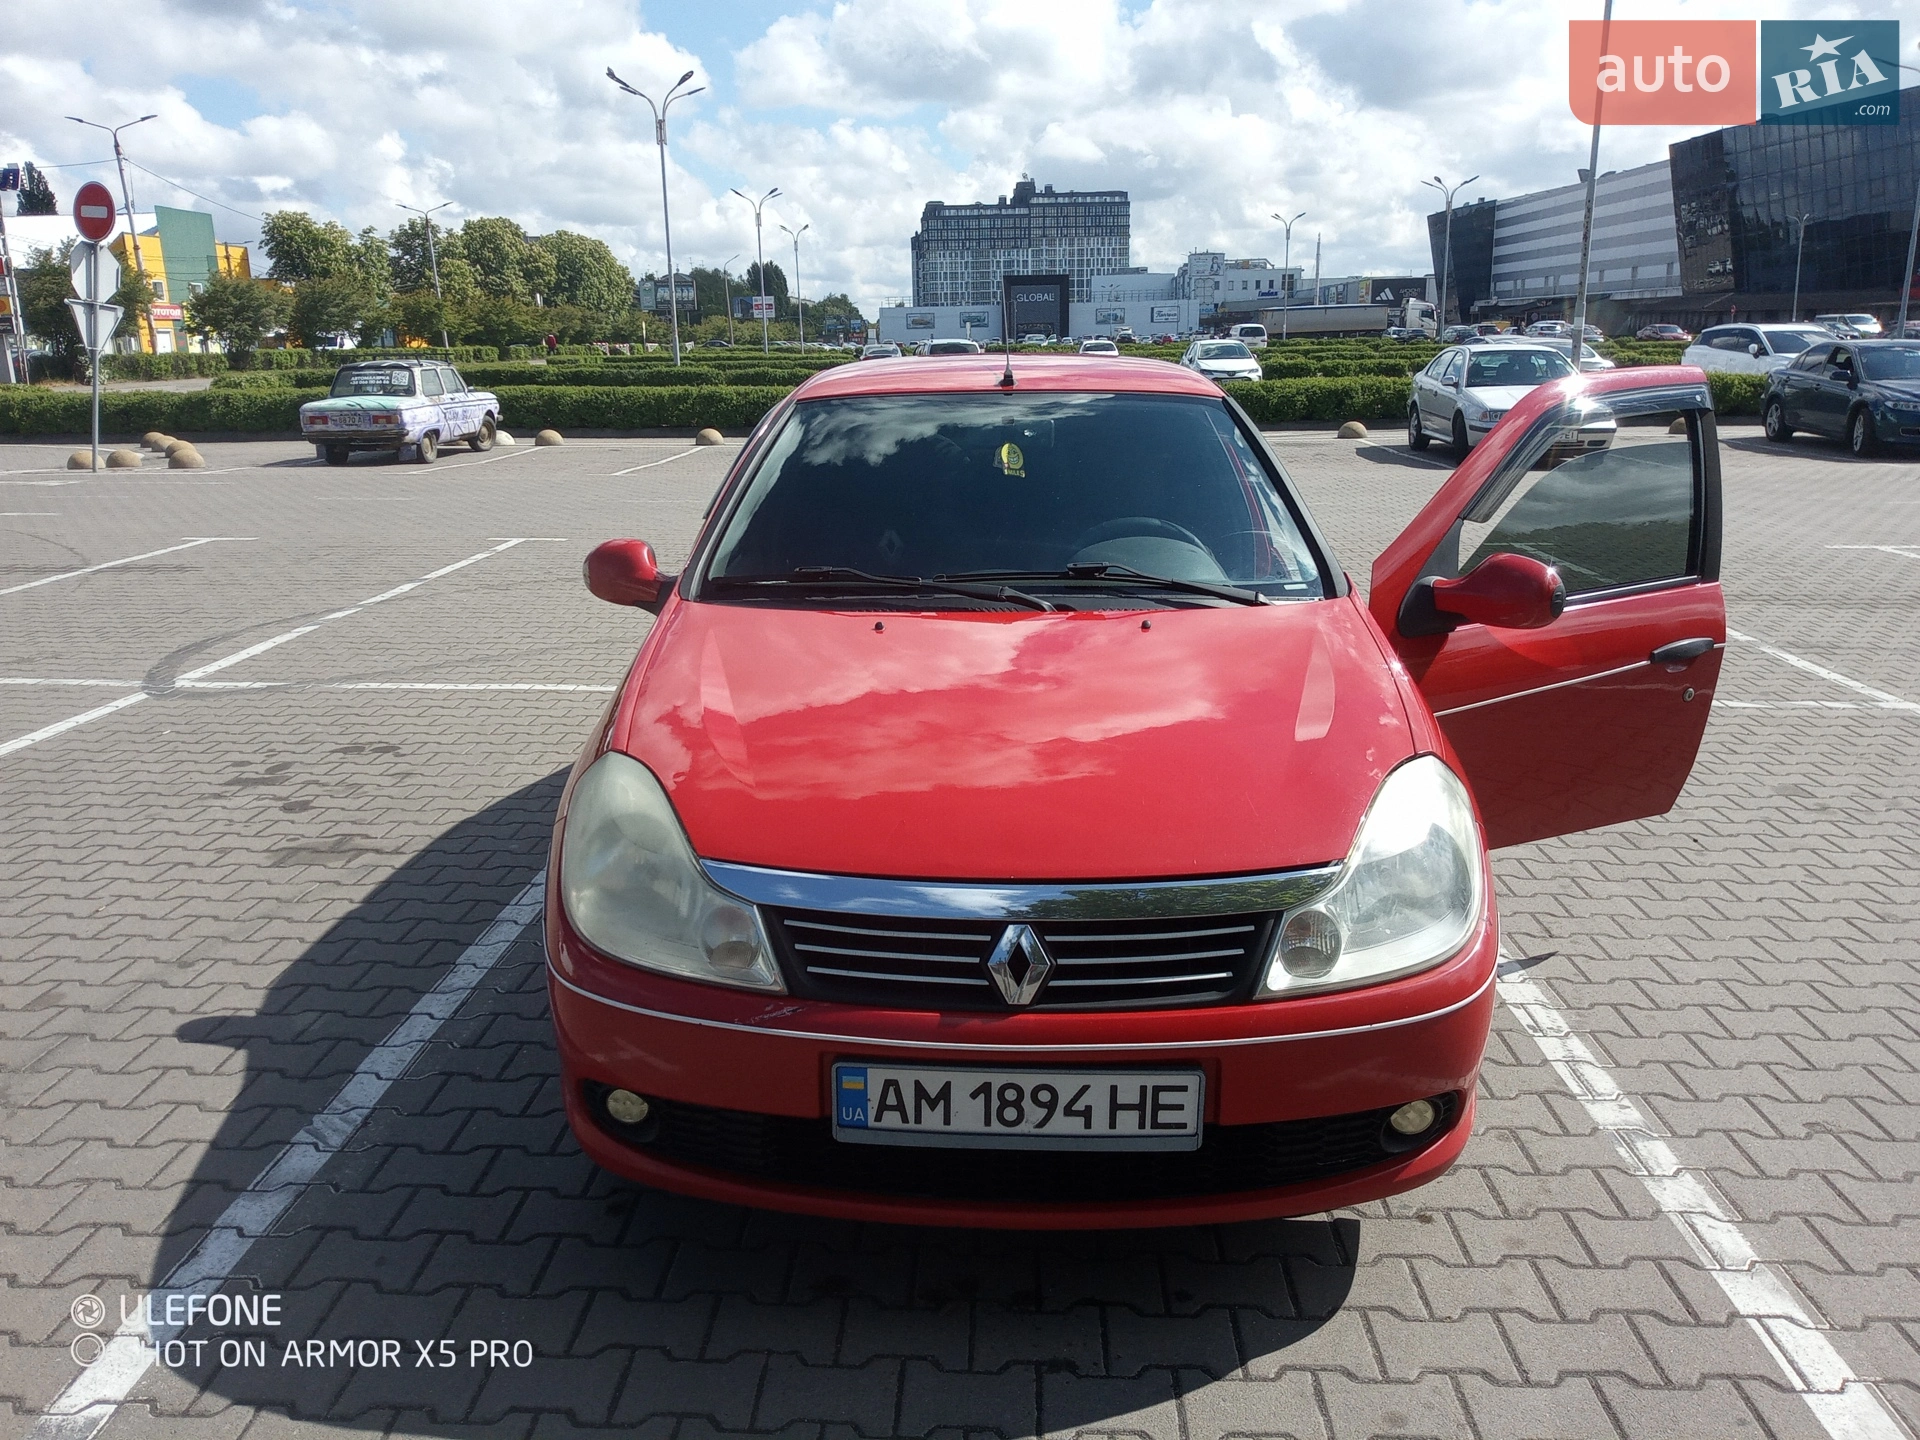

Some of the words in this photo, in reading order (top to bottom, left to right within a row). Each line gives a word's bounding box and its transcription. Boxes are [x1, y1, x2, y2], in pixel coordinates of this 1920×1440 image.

[1016, 292, 1055, 302] GLOBAL
[151, 308, 181, 316] ОТОТОП
[873, 1078, 952, 1127] AM
[968, 1081, 1093, 1130] 1894
[1108, 1084, 1189, 1130] HE
[842, 1107, 865, 1122] UA
